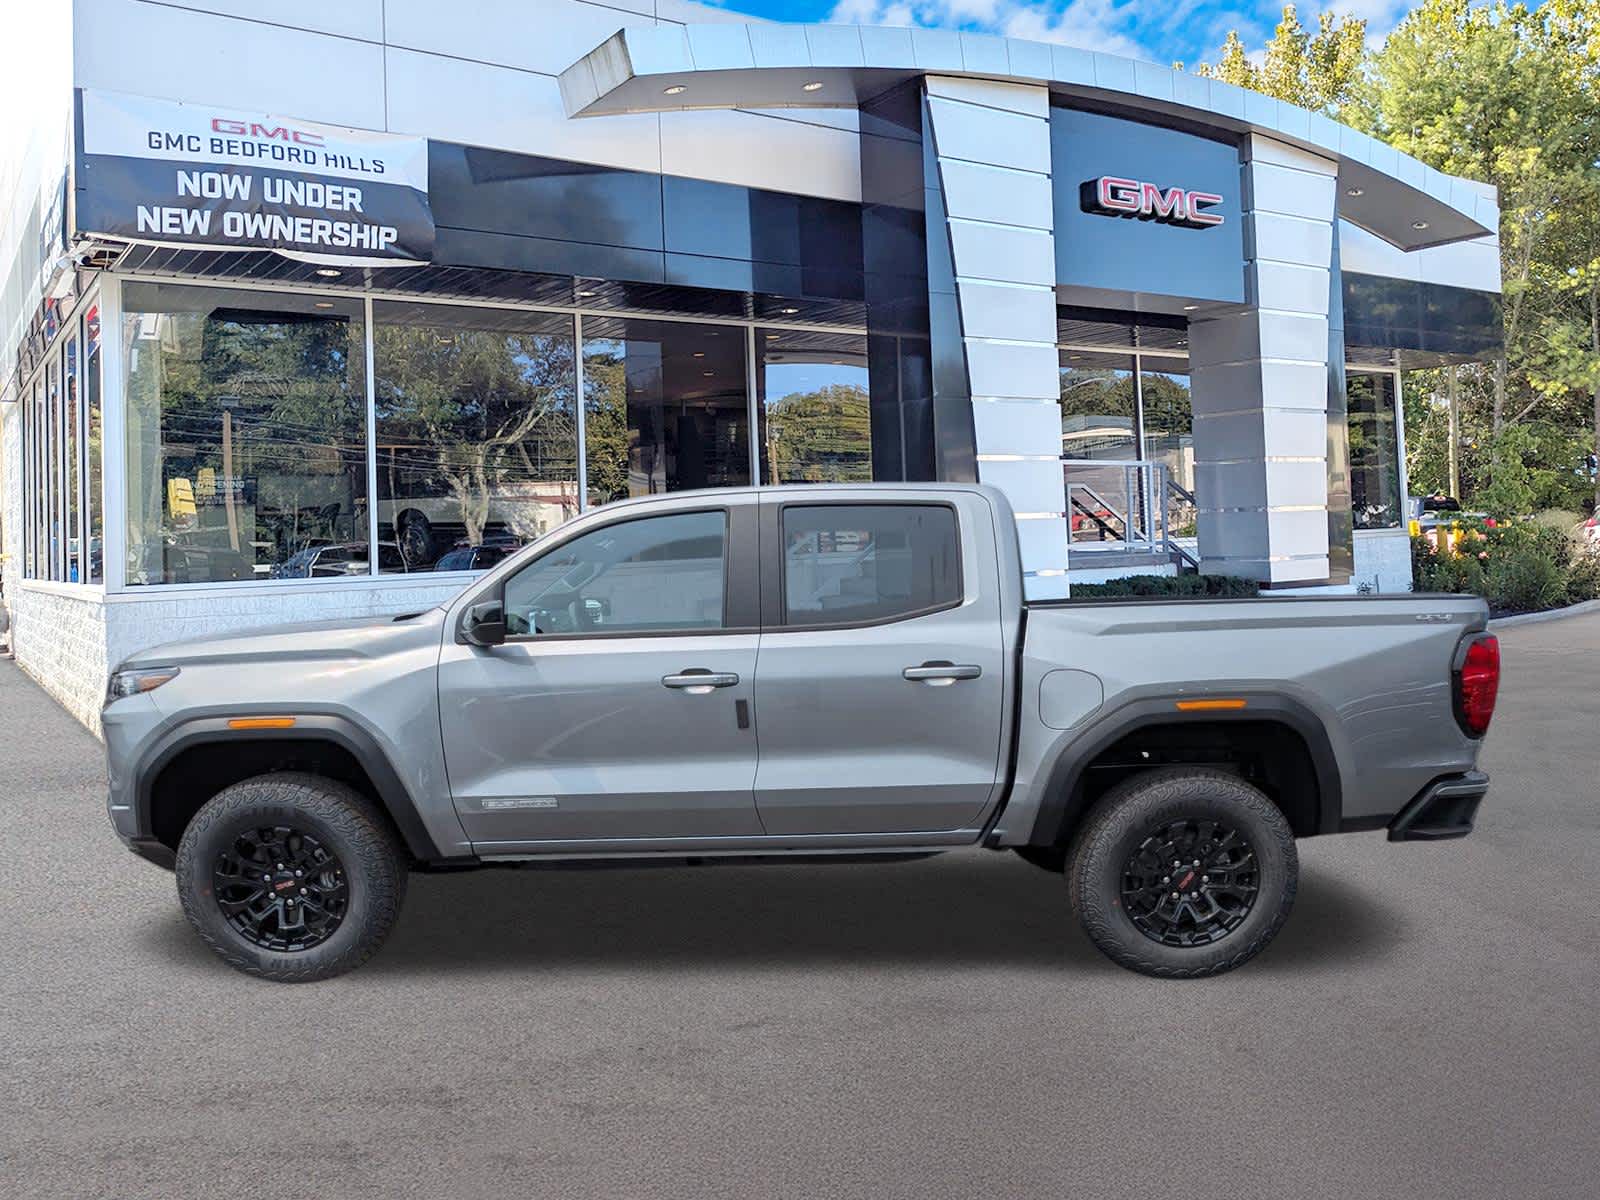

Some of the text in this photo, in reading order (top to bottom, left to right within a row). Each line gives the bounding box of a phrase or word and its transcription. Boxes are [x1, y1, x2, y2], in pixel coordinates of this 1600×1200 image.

[148, 131, 386, 174] GMC BEDFORD HILLS
[211, 118, 325, 147] GMC
[177, 171, 363, 212] NOW UNDER
[1097, 176, 1224, 224] GMC
[137, 206, 398, 250] NEW OWNERSHIP
